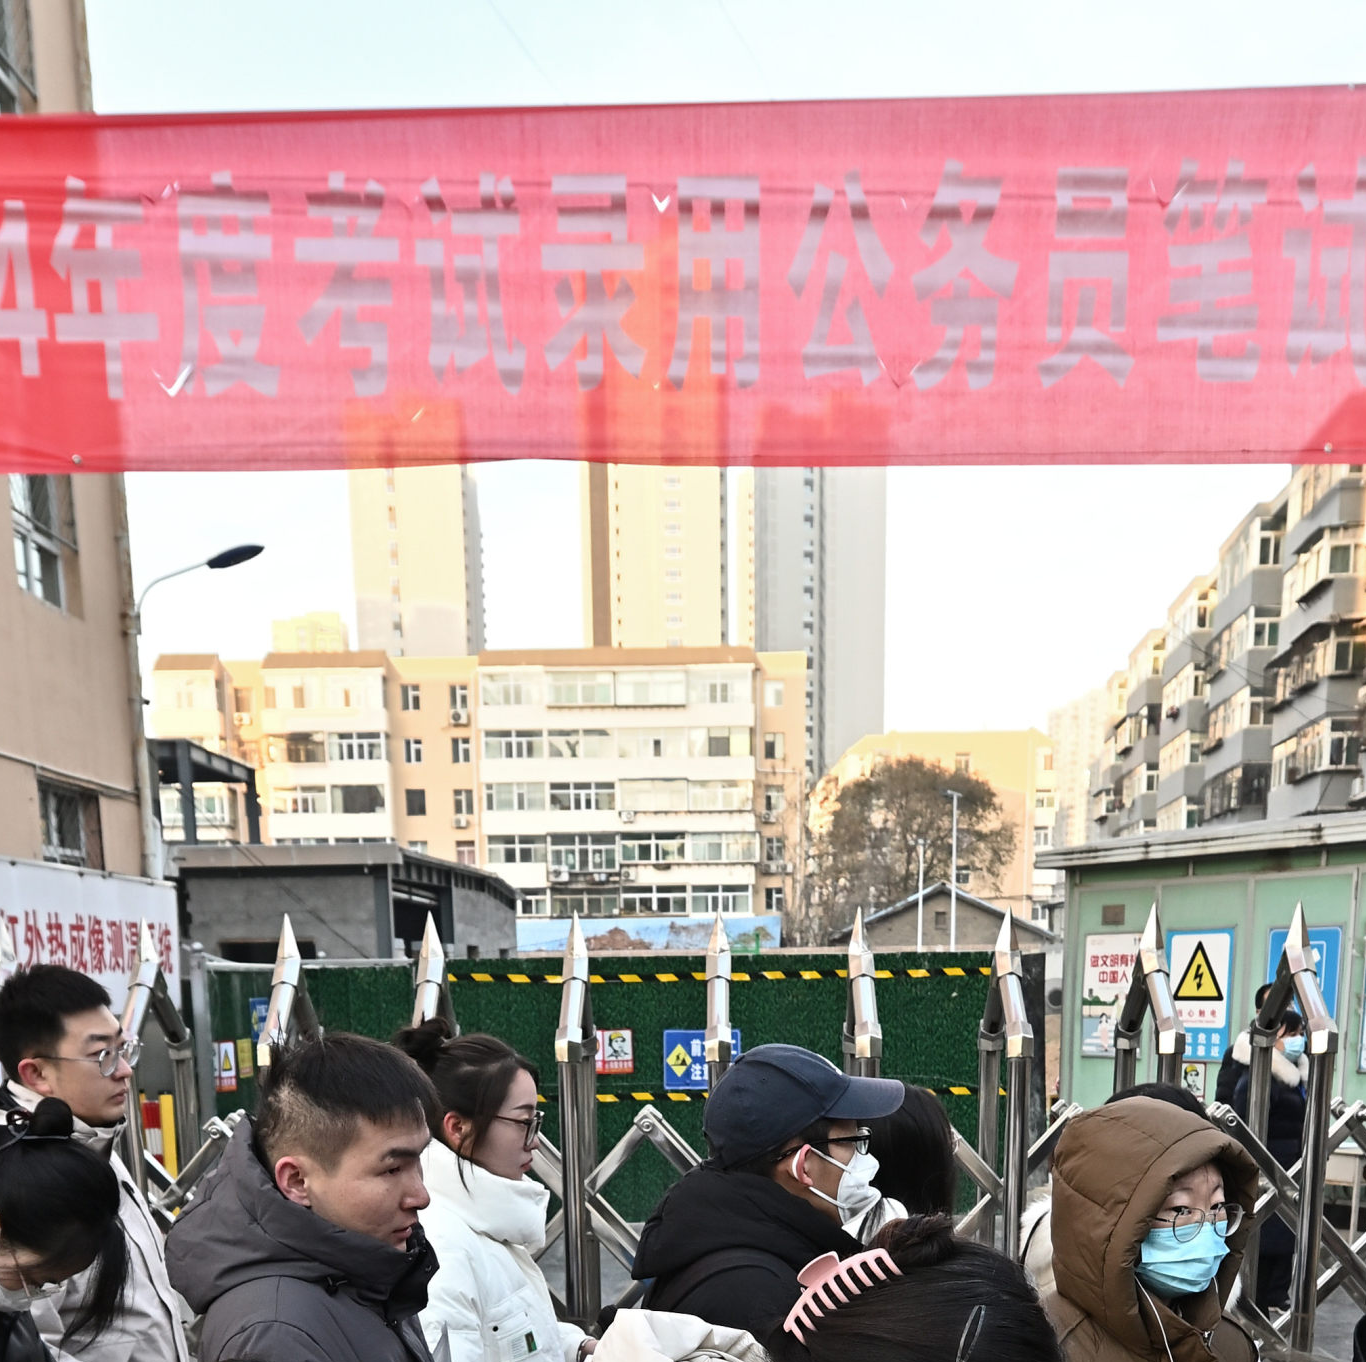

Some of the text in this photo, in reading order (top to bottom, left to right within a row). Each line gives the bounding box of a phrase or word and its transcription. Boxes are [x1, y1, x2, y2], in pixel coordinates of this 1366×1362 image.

[1098, 970, 1130, 983] 中国人
[1185, 1032, 1220, 1045] 压危险
[1185, 1045, 1219, 1057] 勿靠近
